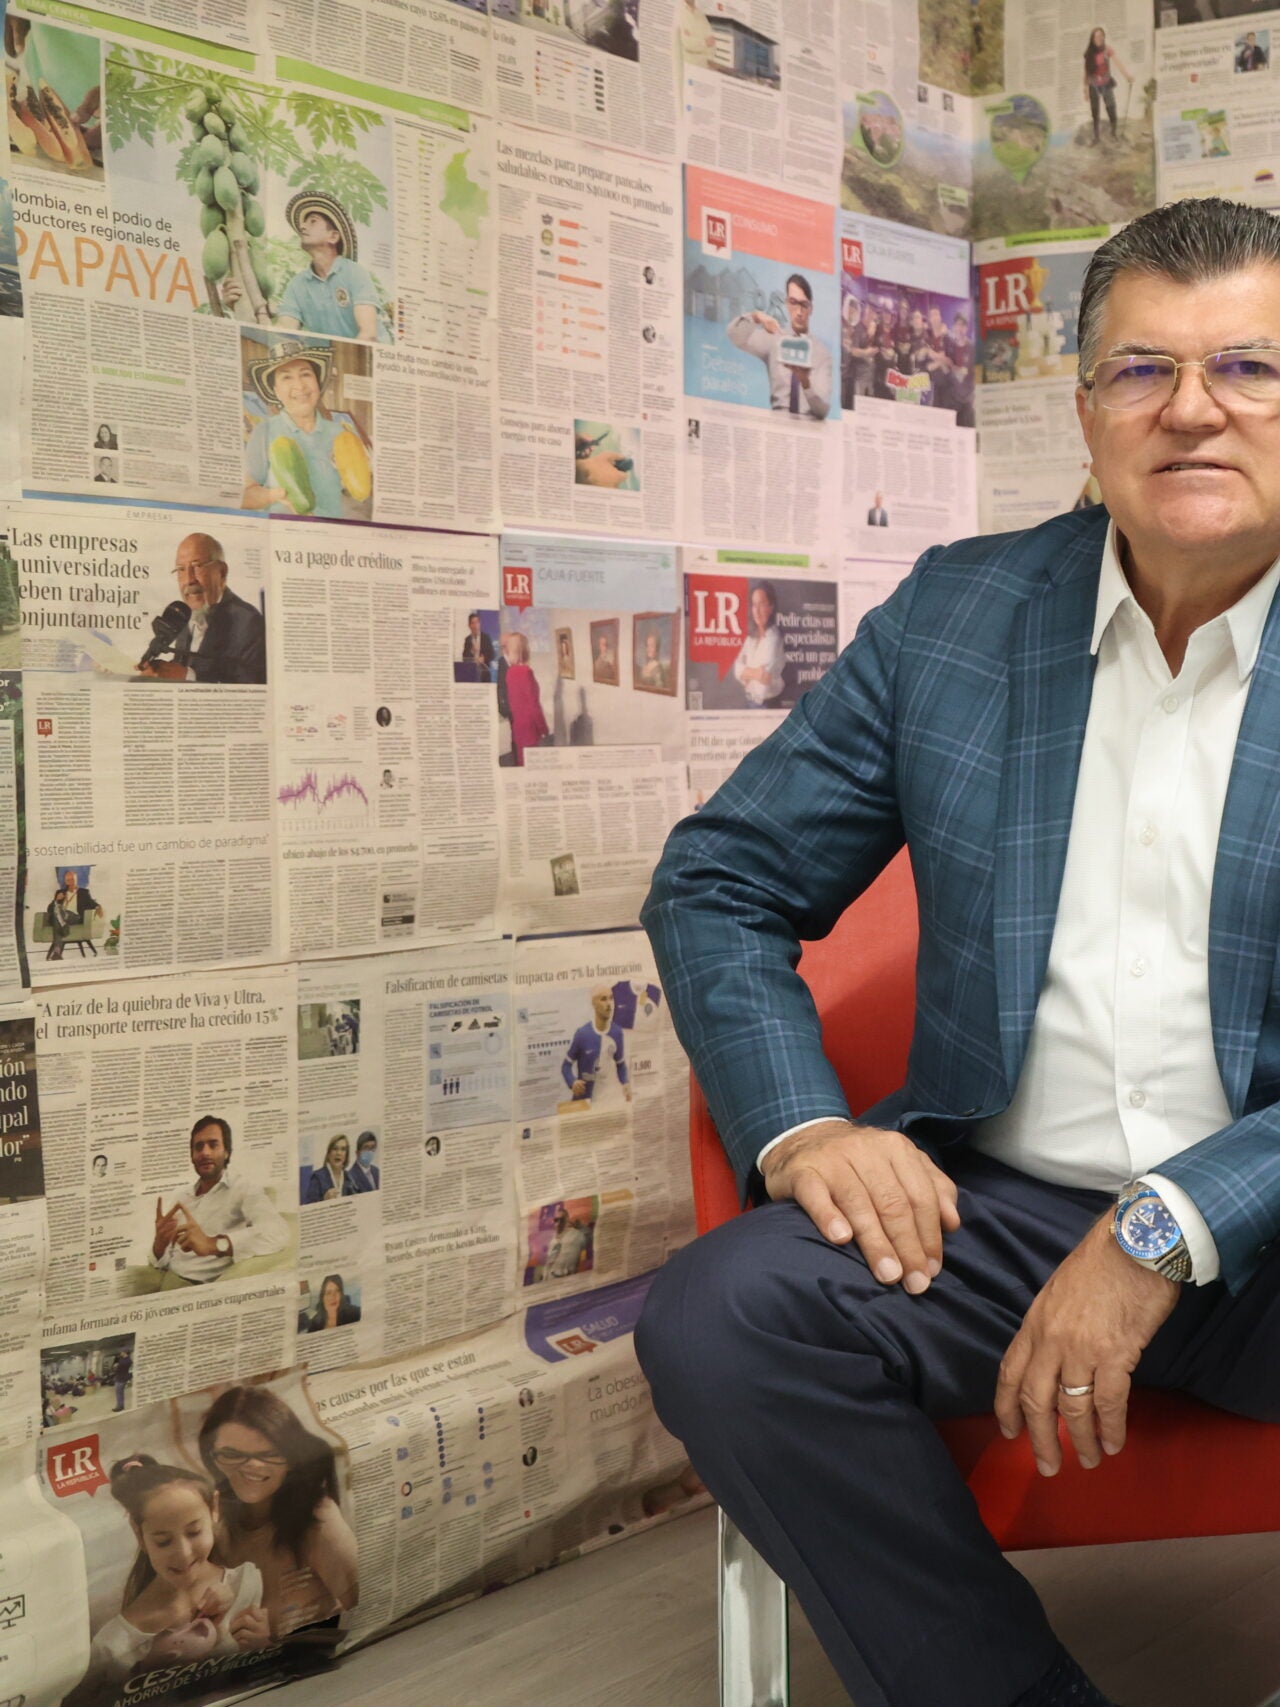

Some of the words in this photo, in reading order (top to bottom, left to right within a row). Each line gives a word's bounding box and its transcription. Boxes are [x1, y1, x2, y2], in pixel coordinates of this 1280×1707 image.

[549, 174, 585, 193] cuestan
[578, 163, 613, 184] preparar
[12, 188, 71, 215] lombia,
[74, 203, 92, 216] en
[96, 206, 108, 220] el
[112, 211, 152, 229] podio
[155, 218, 173, 233] de
[91, 225, 160, 248] regionales
[163, 237, 181, 252] de
[708, 220, 726, 238] LR
[843, 244, 863, 264] LR
[984, 272, 1031, 316] LR
[126, 510, 173, 521] EMPRESAS
[50, 533, 138, 554] empresas
[22, 555, 150, 579] universidades
[275, 550, 291, 564] va
[295, 551, 303, 564] a
[307, 551, 338, 570] pago
[340, 550, 355, 567] de
[357, 552, 404, 570] créditos
[506, 573, 530, 594] LR
[568, 569, 606, 585] FUERTE
[69, 583, 140, 608] trabajar
[694, 590, 742, 635] LR
[776, 613, 800, 627] Pedir
[705, 636, 743, 647] REPÚBLICA
[34, 838, 114, 858] sostenibilidad
[117, 838, 138, 853] fue
[141, 842, 153, 852] un
[156, 837, 196, 853] cambio
[198, 837, 212, 849] de
[385, 976, 445, 995] Falsificación
[447, 974, 460, 989] de
[461, 973, 508, 988] camisetas
[515, 971, 554, 988] impacta
[570, 969, 584, 981] 7%
[596, 962, 643, 979] facturación
[56, 1001, 83, 1017] raíz
[86, 998, 103, 1014] de
[107, 997, 118, 1014] la
[122, 994, 173, 1017] quiebra
[175, 993, 191, 1009] de
[194, 992, 220, 1007] Viva
[36, 1023, 48, 1039] el
[56, 1020, 128, 1039] transporte
[132, 1015, 187, 1033] terrestre
[190, 1011, 205, 1028] ha
[208, 1010, 252, 1026] crecido
[80, 1312, 120, 1332] formará
[129, 1308, 143, 1322] 66
[144, 1303, 181, 1323] jóvenes
[196, 1295, 222, 1310] temas
[224, 1284, 286, 1306] empresariales
[582, 1316, 619, 1335] SALUD
[329, 1388, 367, 1409] causas
[369, 1380, 388, 1398] por
[390, 1373, 408, 1388] las
[410, 1366, 430, 1384] que
[432, 1363, 445, 1375] se
[447, 1351, 476, 1370] están
[588, 1384, 602, 1402] La
[590, 1393, 637, 1423] mundo
[52, 1446, 97, 1482] LR
[114, 1683, 170, 1707] AHORRO
[173, 1674, 192, 1689] DE
